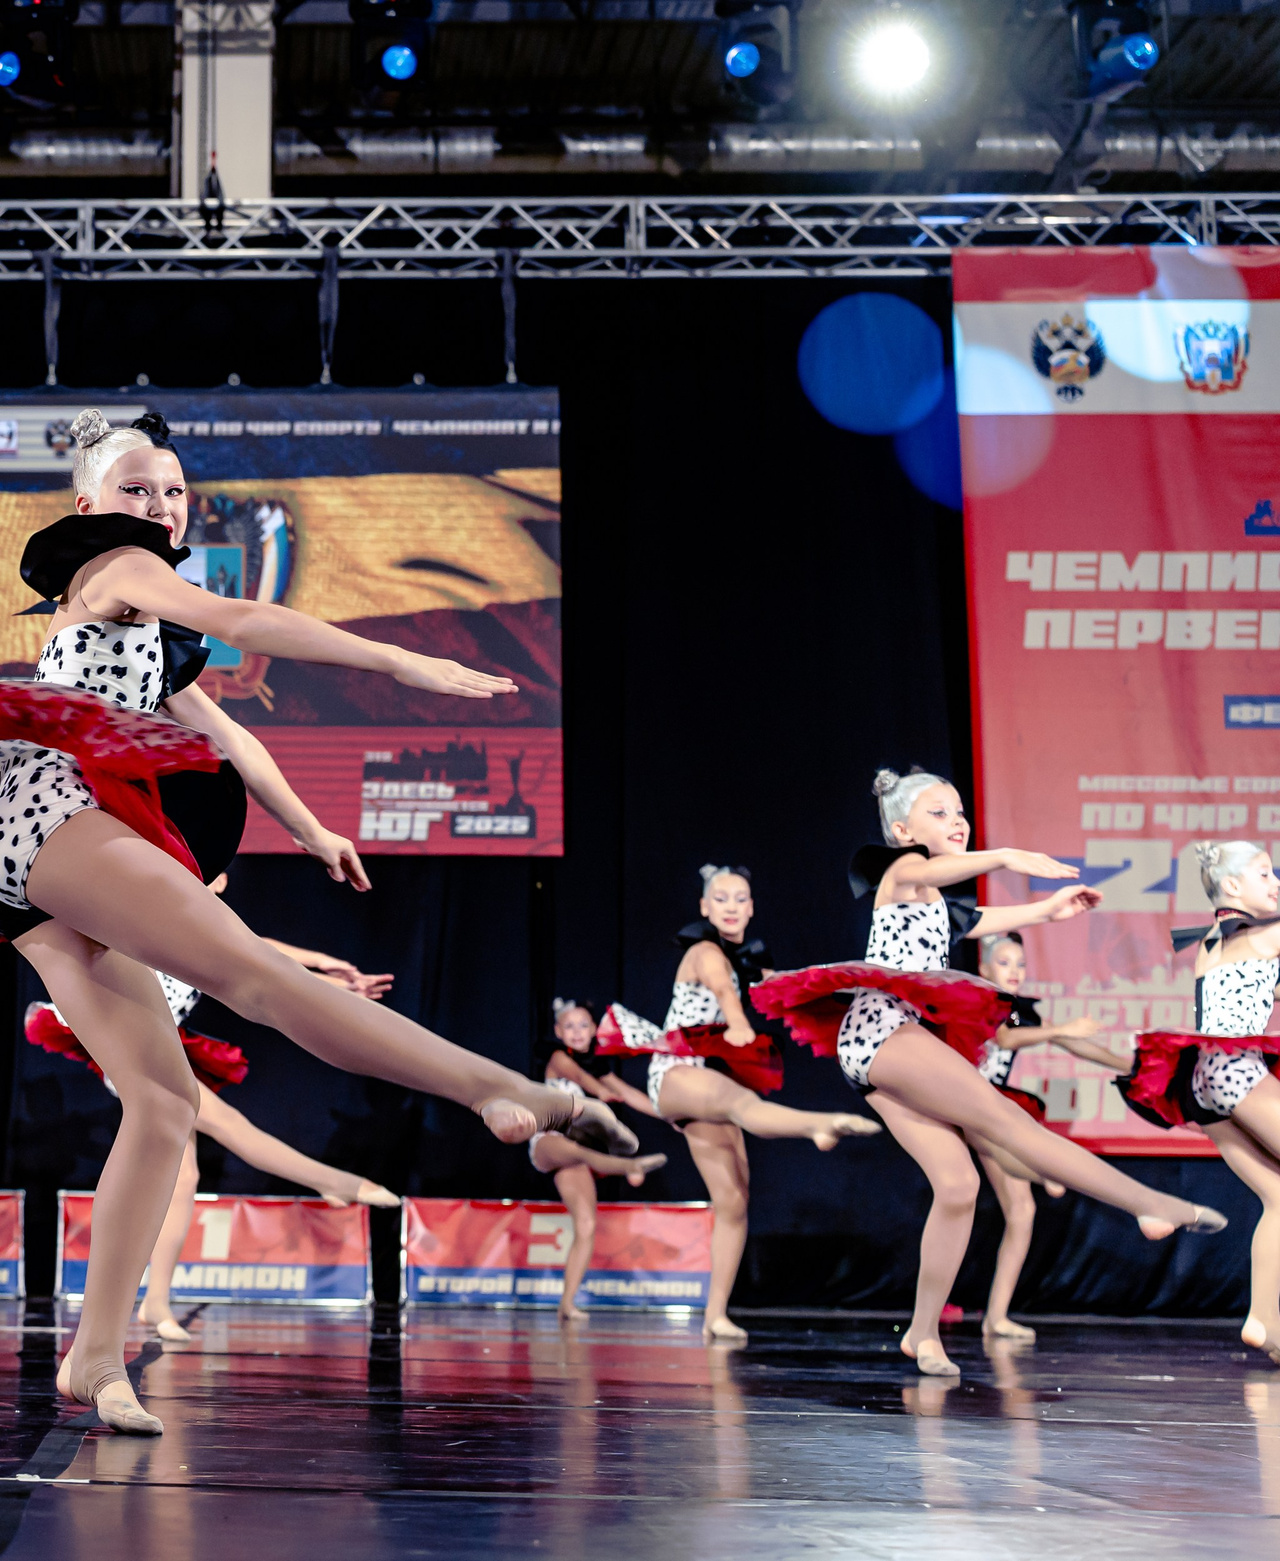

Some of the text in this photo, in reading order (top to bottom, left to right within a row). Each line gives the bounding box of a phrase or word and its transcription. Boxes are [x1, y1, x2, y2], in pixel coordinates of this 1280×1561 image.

[393, 420, 531, 436] ЧЕМПИОНАТ
[361, 781, 455, 800] ЗДЕСЬ
[1078, 775, 1229, 793] МАССОВЫЕ
[359, 811, 531, 841] ЮГ 2025
[1080, 803, 1145, 831] ПО
[1152, 803, 1248, 832] ЧИР
[1033, 998, 1196, 1029] ОСТО
[197, 1208, 234, 1260] 1
[527, 1213, 576, 1265] 3
[140, 1266, 308, 1291] МПИОН
[418, 1275, 702, 1298] ВТОРОЙ ВИЦ-ЧЕМПИОН
